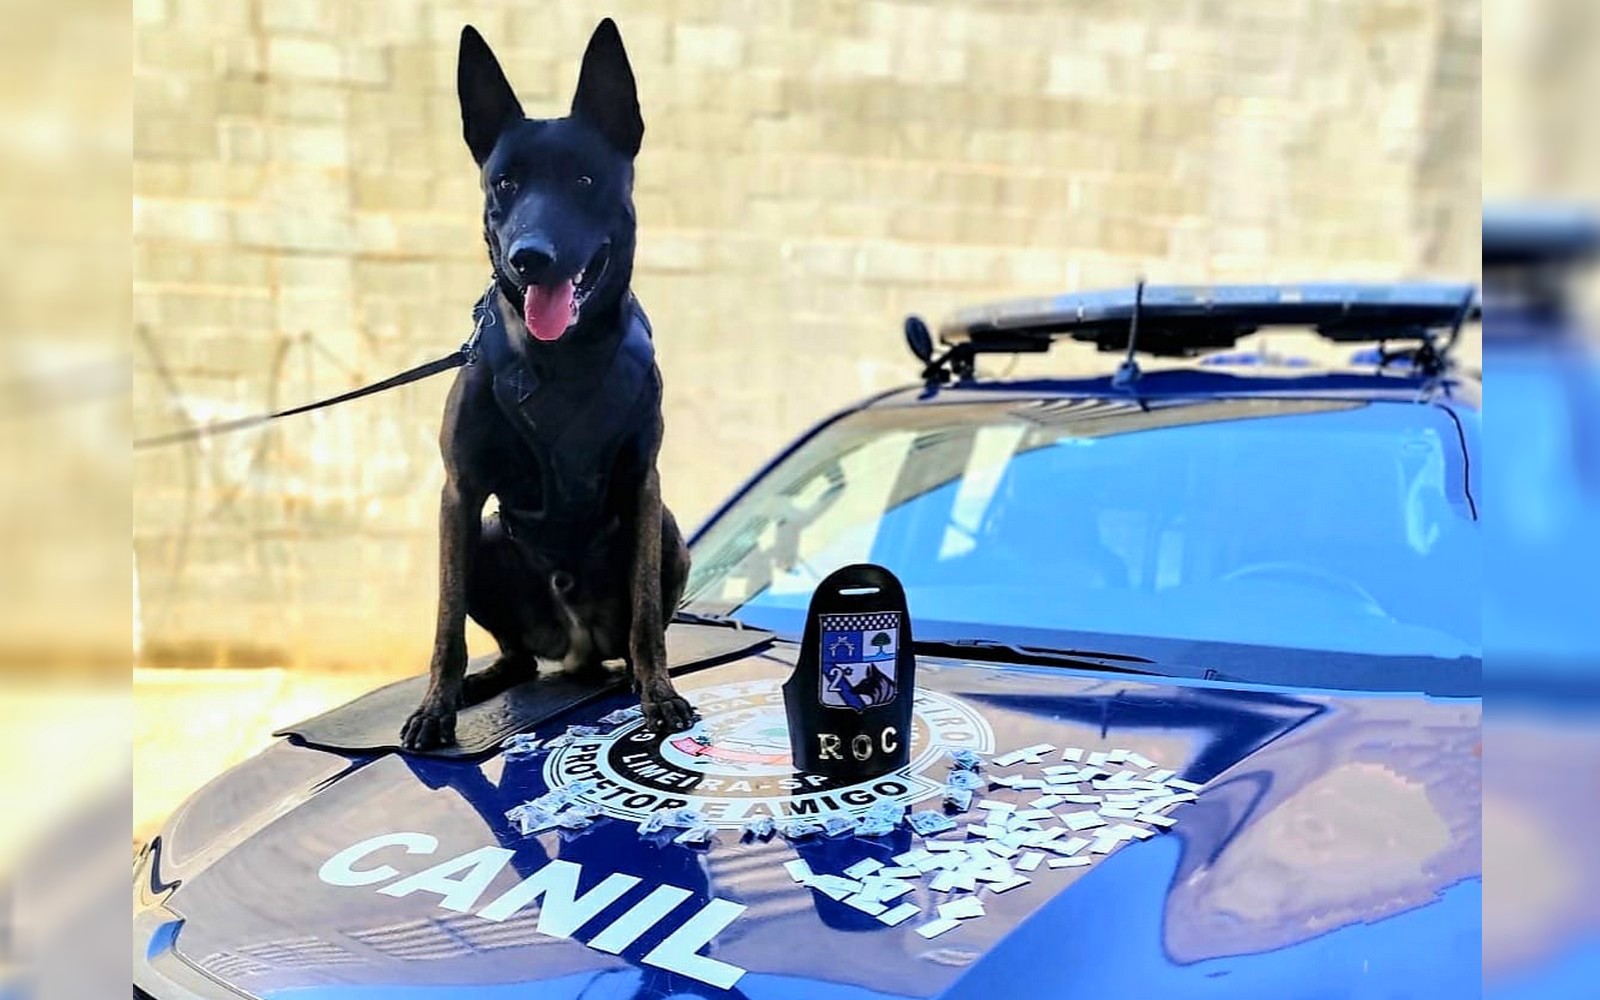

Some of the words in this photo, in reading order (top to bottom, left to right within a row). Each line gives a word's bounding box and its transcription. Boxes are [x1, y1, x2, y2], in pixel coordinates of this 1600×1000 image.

[817, 726, 898, 761] ROC
[621, 752, 829, 793] LIMEIRA-SP
[699, 801, 730, 819] E
[741, 781, 908, 819] AMIGO
[317, 831, 749, 991] CANIL
